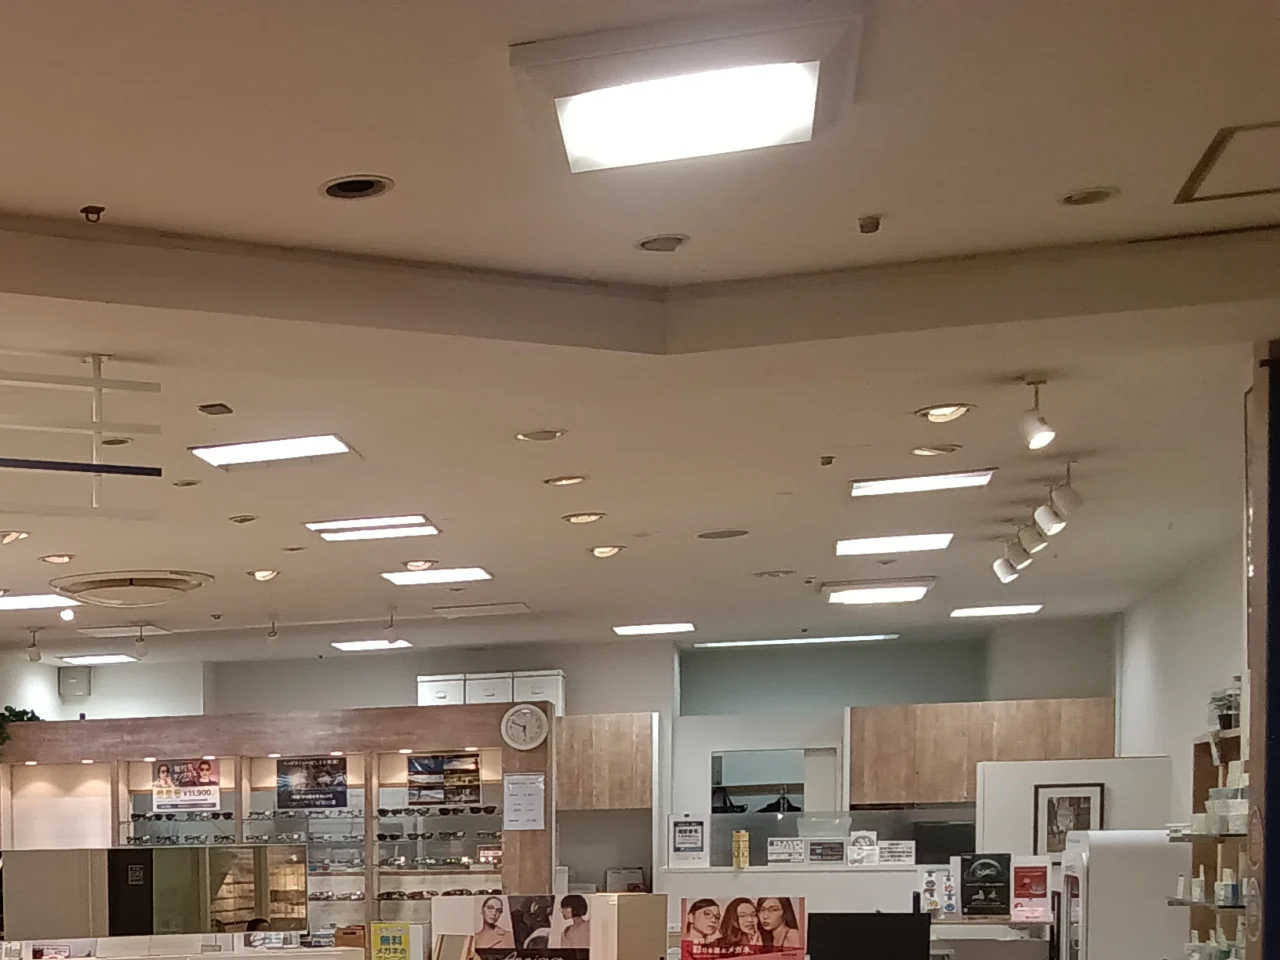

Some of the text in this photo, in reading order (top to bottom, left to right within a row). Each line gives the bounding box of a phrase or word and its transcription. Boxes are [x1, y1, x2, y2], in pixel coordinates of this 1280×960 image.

[380, 935, 402, 946] 無料
[375, 947, 407, 956] メガネの
